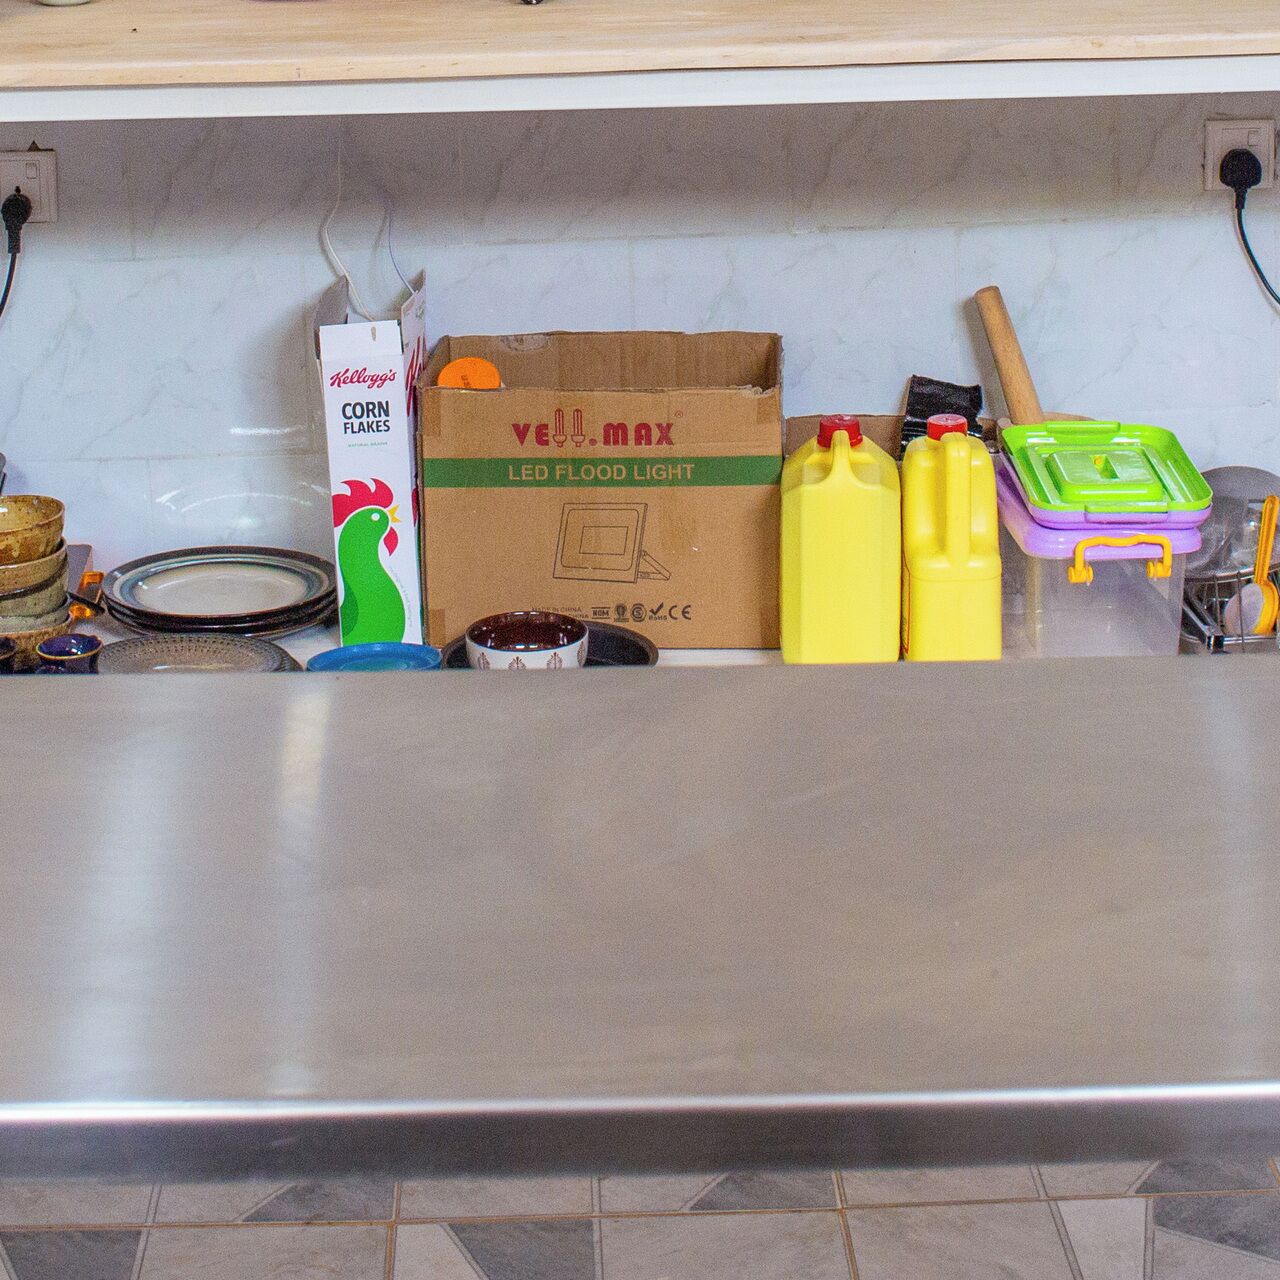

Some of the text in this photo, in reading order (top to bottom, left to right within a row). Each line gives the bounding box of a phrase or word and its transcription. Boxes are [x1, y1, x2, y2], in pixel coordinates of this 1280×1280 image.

[329, 367, 398, 389] Kellogg's
[341, 401, 390, 420] CORN
[343, 420, 391, 434] FLAKES
[508, 463, 695, 480] LED FLOOD LIGHT
[668, 605, 692, 620] CE
